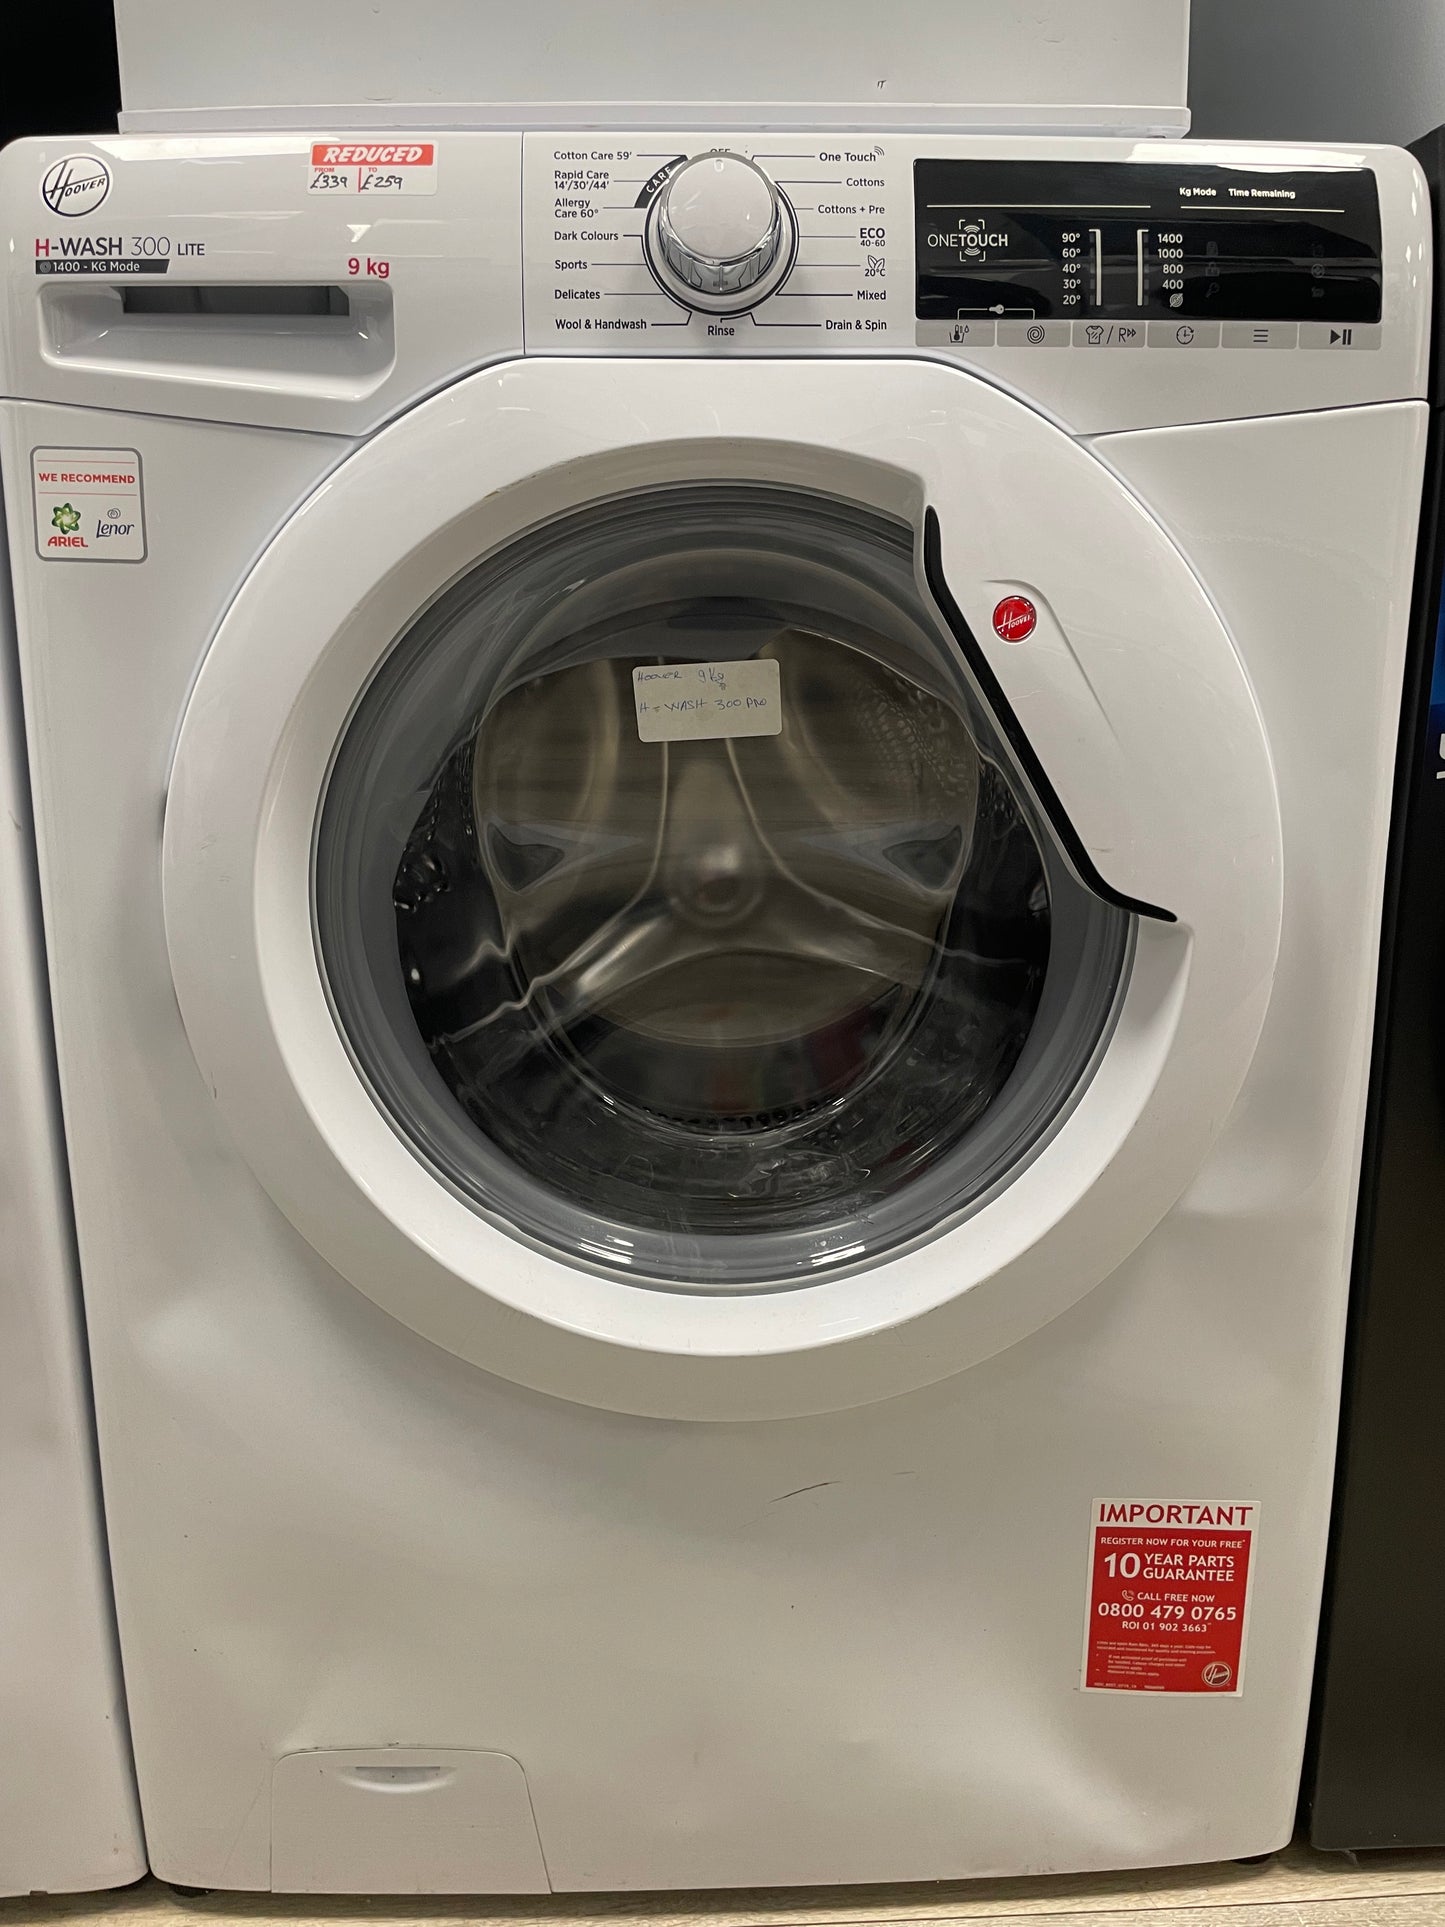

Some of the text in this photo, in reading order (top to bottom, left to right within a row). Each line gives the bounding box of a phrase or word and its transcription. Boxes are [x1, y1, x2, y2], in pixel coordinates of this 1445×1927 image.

[323, 146, 423, 163] REDUCED
[553, 151, 632, 160] Cotton Care 59'
[819, 152, 876, 162] One Touch
[310, 172, 348, 189] £339
[554, 170, 609, 181] Rapid Care
[646, 166, 672, 193] CARE
[44, 160, 107, 210] HOOVER
[361, 174, 403, 190] £259
[554, 180, 609, 191] 14'/30'/44'
[846, 177, 885, 187] Cottons
[1179, 187, 1217, 197] Kg Mode
[1228, 188, 1296, 199] Time Remaining
[554, 198, 590, 209] Allergy
[554, 208, 599, 218] Care 60°
[818, 205, 857, 214] Cottons
[869, 205, 885, 214] Pre
[554, 231, 619, 240] Dark Colours
[860, 227, 885, 239] ECO
[1157, 233, 1183, 244] 1400
[35, 236, 205, 257] H-WASH 300 LITE
[1157, 248, 1184, 258] 1000
[53, 261, 81, 272] 1400
[91, 261, 107, 272] KG
[110, 261, 140, 272] Mode
[348, 257, 390, 279] 9 kg
[554, 260, 588, 271] Sports
[1162, 264, 1184, 274] 800
[864, 268, 886, 277] 20°C
[1162, 279, 1184, 289] 400
[554, 289, 601, 300] Delicates
[857, 290, 887, 300] Mixed
[555, 319, 647, 330] Wool & Handwash
[825, 319, 887, 332] Drain & Spin
[707, 325, 735, 336] Rinse
[38, 472, 136, 484] WE RECOMMEND
[96, 519, 135, 539] Lenor
[47, 536, 89, 548] ARIEL
[714, 700, 742, 711] 300
[1099, 1503, 1253, 1526] IMPORTANT
[1101, 1537, 1144, 1545] REGISTER
[1146, 1538, 1168, 1546] NOW
[1171, 1538, 1189, 1547] FOR
[1192, 1539, 1217, 1548] YOUR
[1104, 1552, 1234, 1578] 10 YEAR PARTS
[1143, 1567, 1235, 1582] GUARANTEE
[1137, 1591, 1215, 1603] CALL FREE NOW
[1098, 1602, 1237, 1621] 0800 479 0765
[1122, 1621, 1140, 1630] ROI
[1142, 1621, 1155, 1631] 01
[1159, 1622, 1179, 1632] 902
